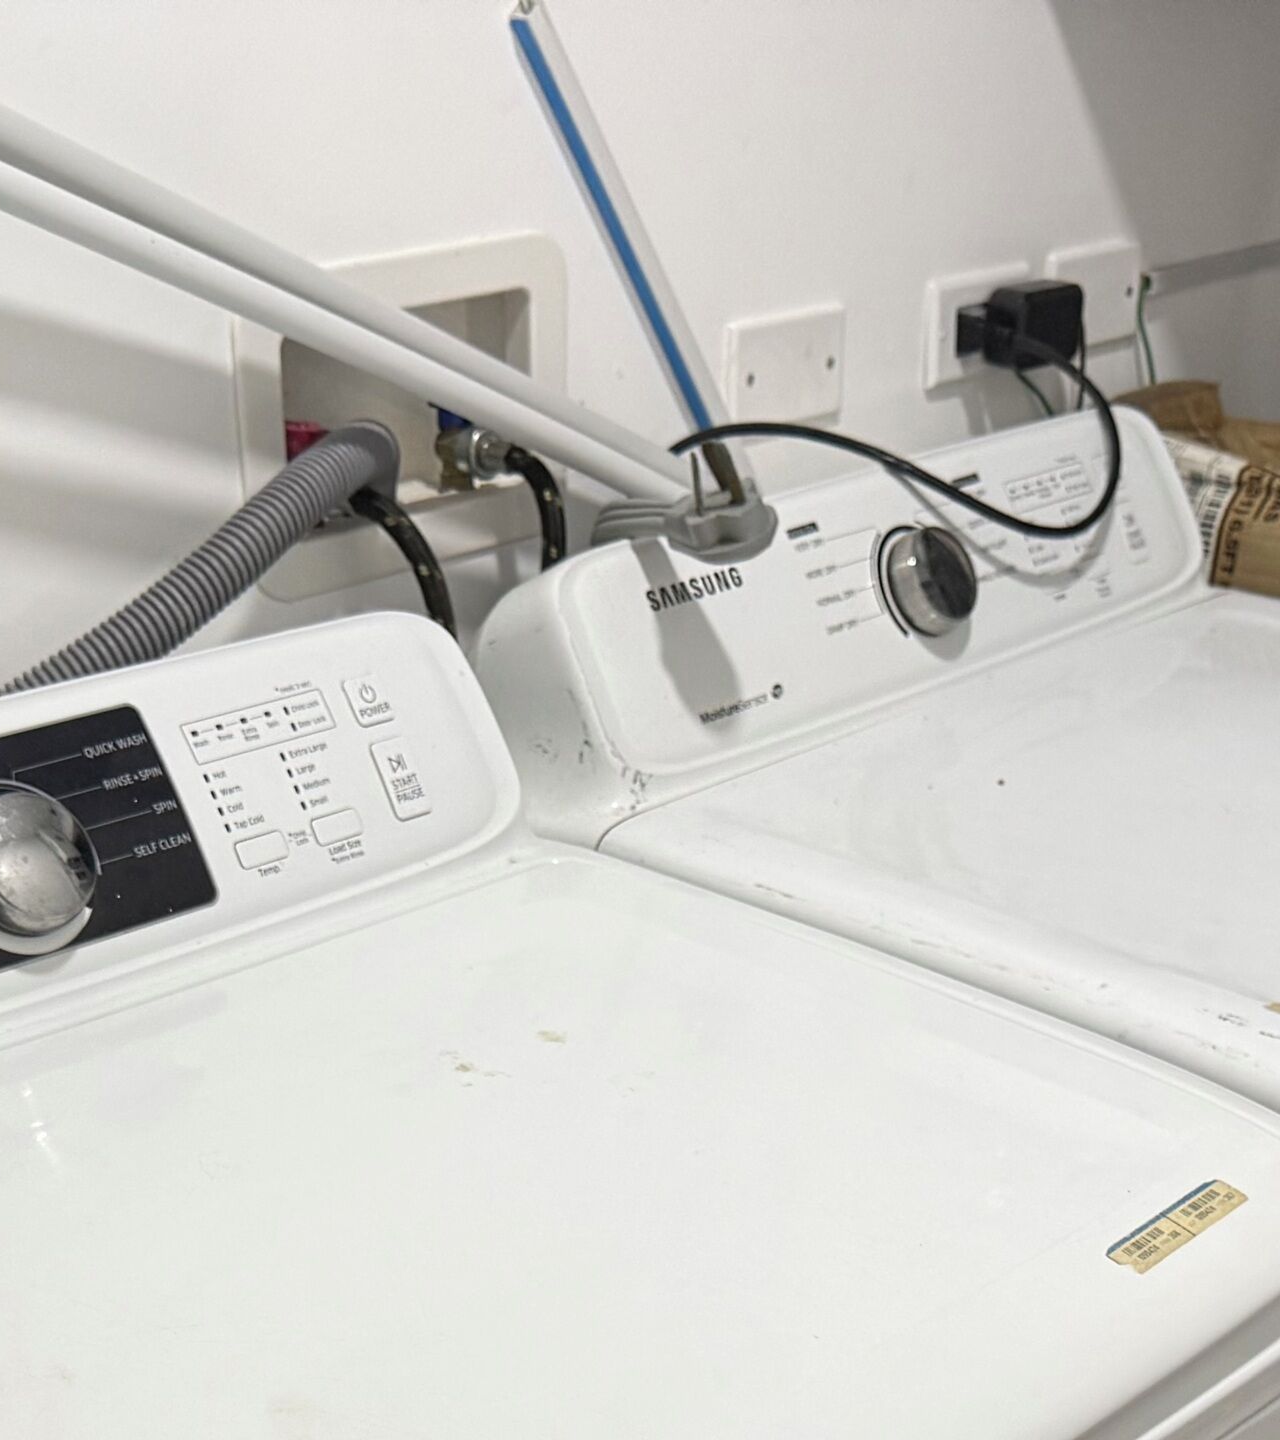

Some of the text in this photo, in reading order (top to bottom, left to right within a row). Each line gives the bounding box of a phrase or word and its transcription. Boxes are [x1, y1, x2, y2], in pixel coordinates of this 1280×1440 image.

[646, 568, 743, 613] SAMSUNG
[359, 701, 392, 719] POWER
[83, 732, 148, 760] QUICK WASH
[391, 773, 419, 791] START
[396, 787, 425, 804] PAUSE
[152, 799, 178, 815] SPIN
[133, 832, 192, 858] SELF CLEAN
